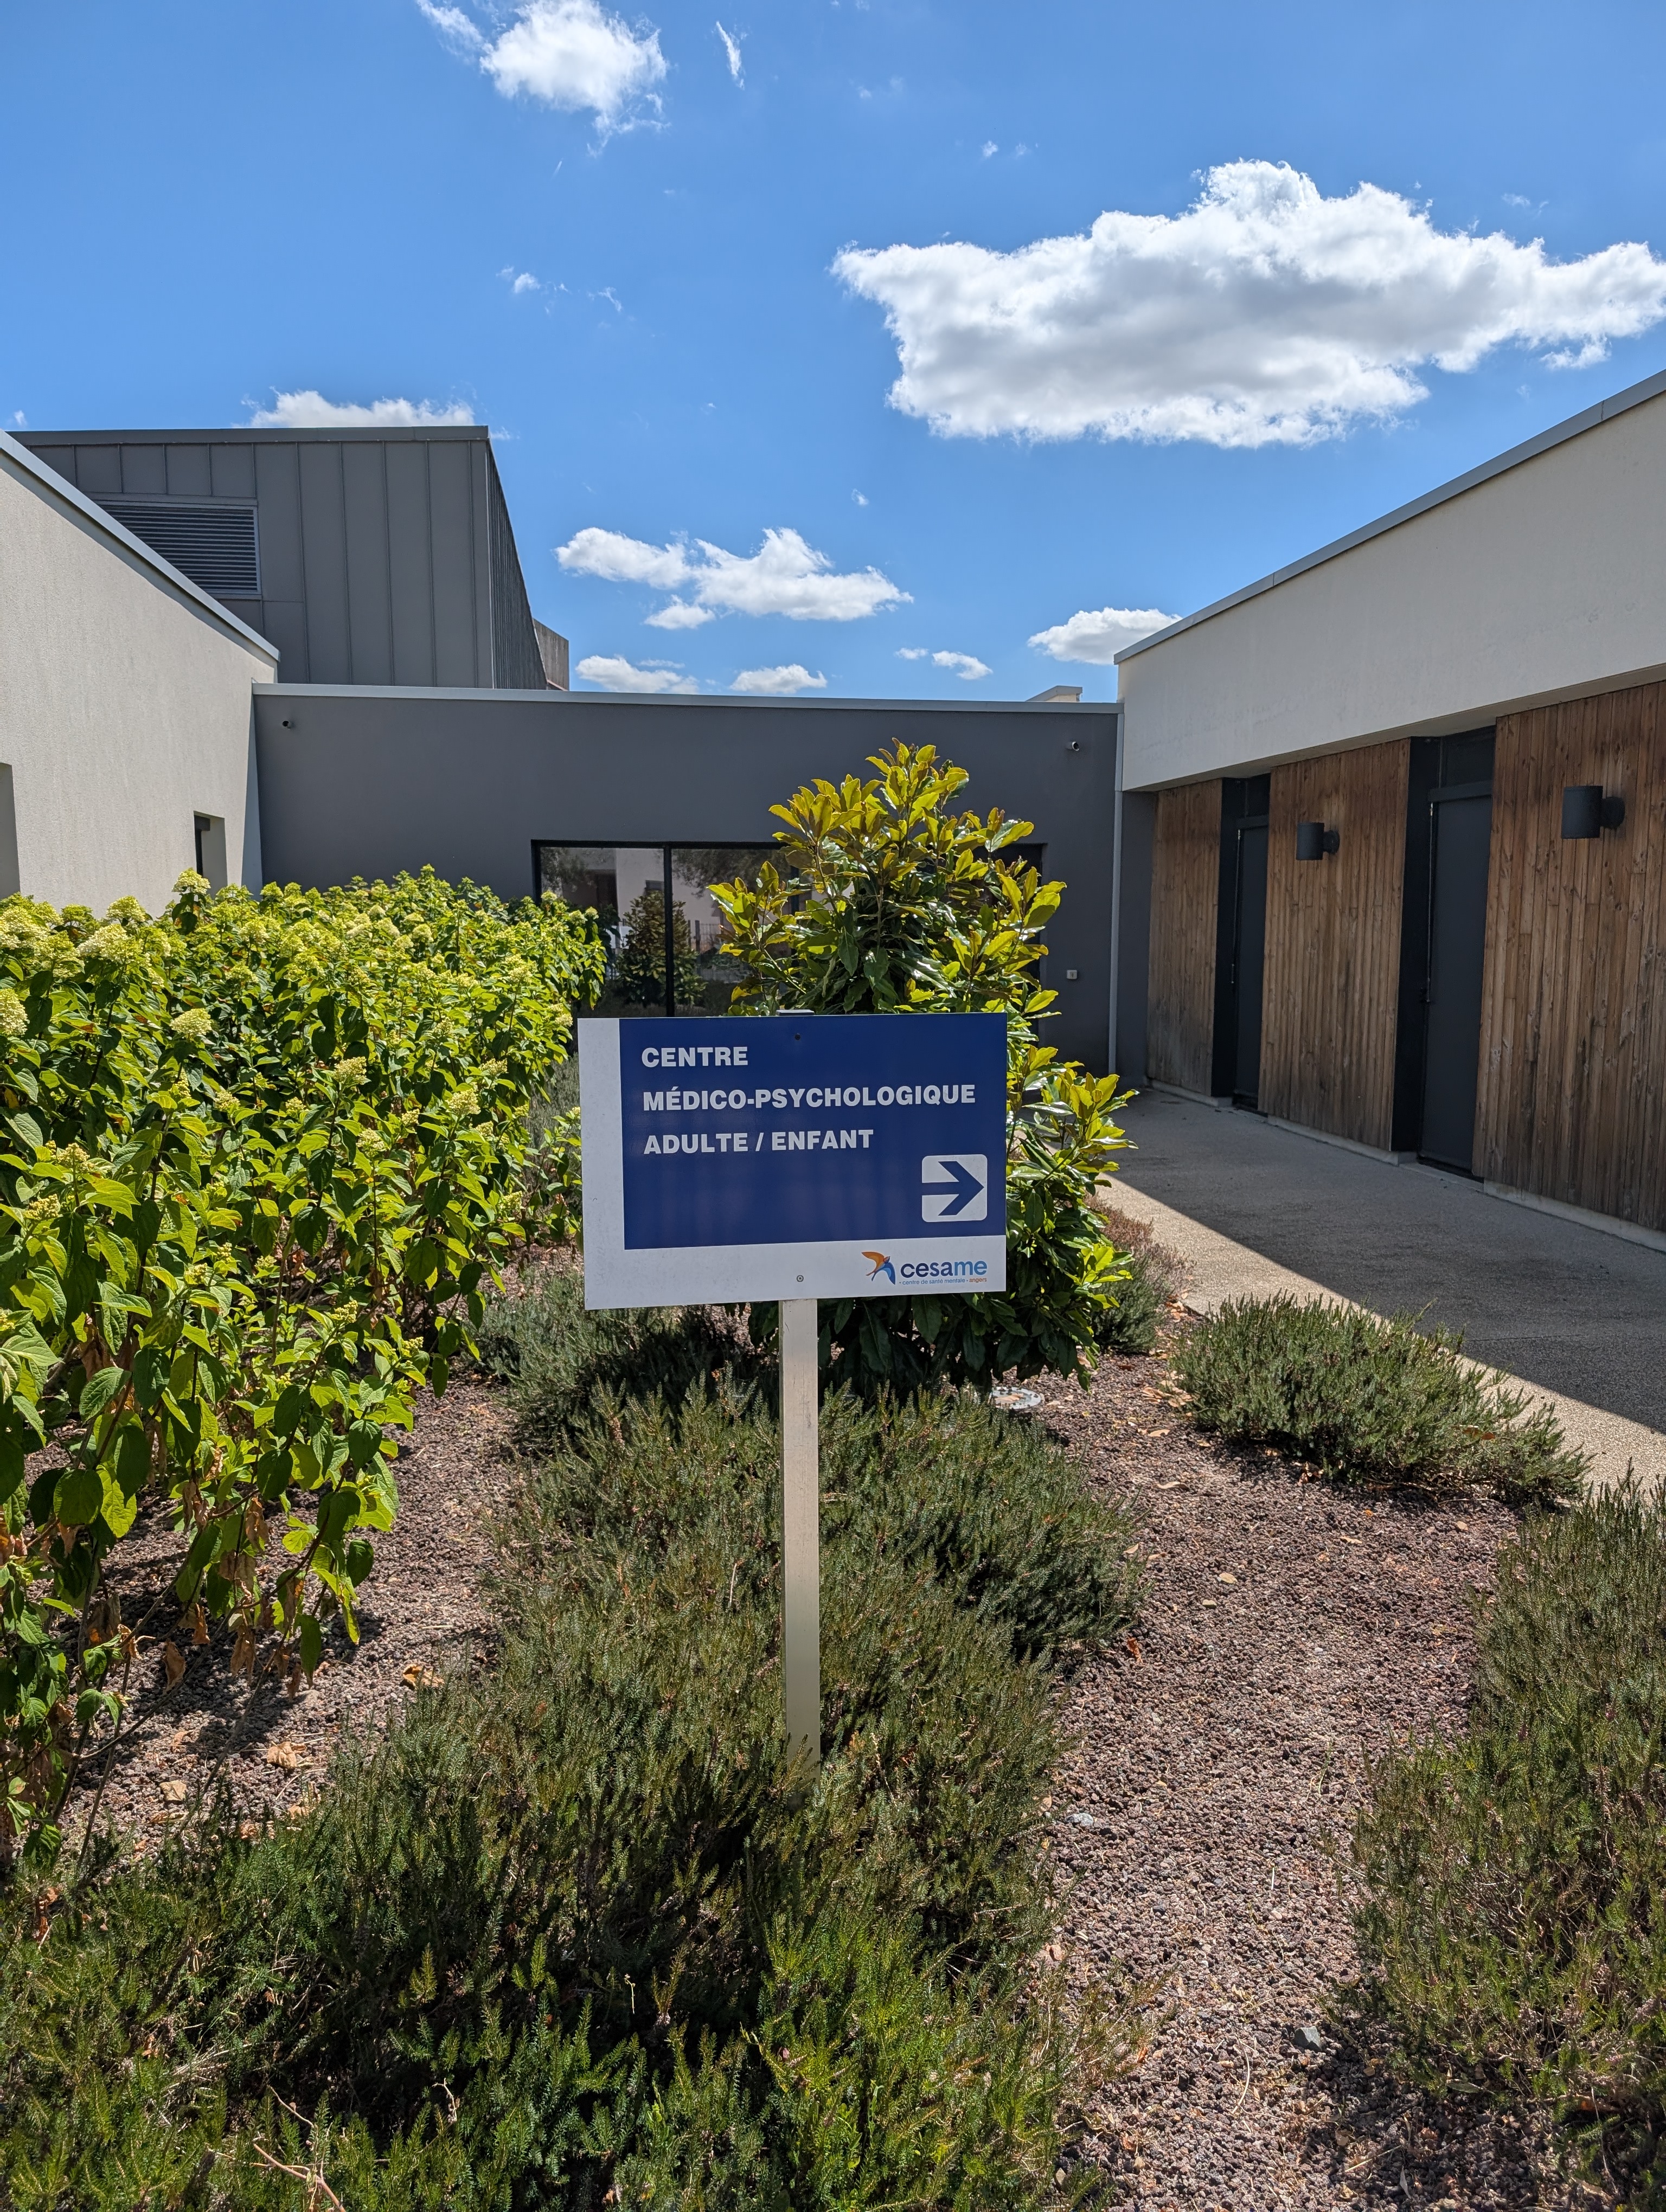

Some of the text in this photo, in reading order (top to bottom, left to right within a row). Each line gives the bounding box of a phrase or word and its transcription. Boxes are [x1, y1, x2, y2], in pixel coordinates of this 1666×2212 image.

[642, 1046, 748, 1068] CENTRE
[643, 1084, 976, 1111] MÉDICO-PSYCHOLOGIQUE
[643, 1129, 874, 1155] ADULTE / ENFANT
[900, 1261, 988, 1278] cesame
